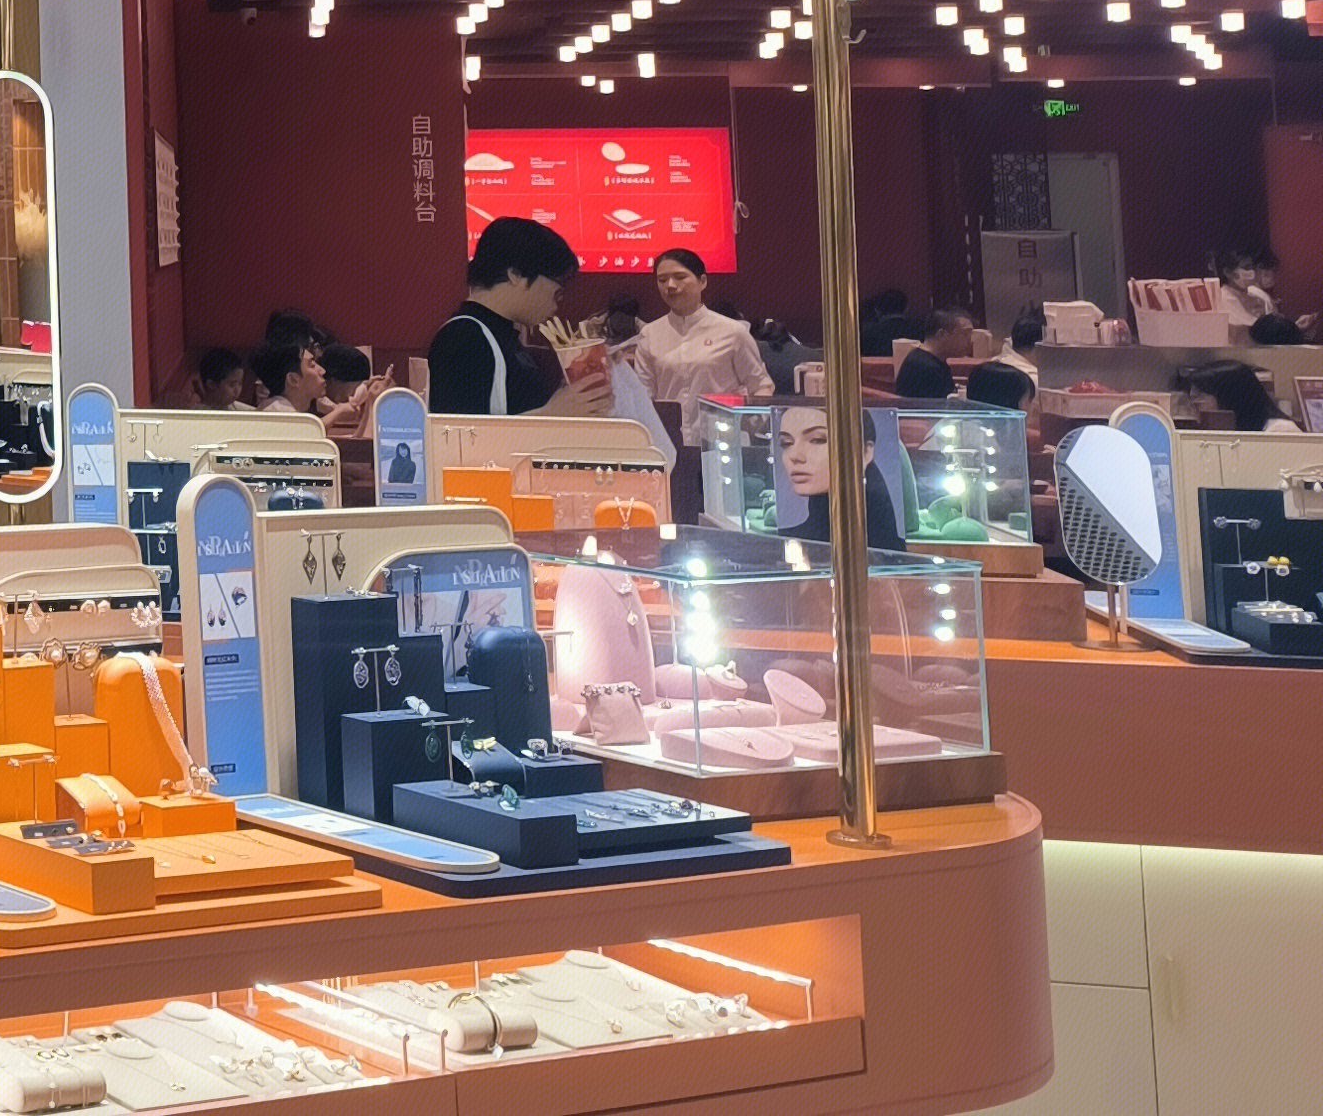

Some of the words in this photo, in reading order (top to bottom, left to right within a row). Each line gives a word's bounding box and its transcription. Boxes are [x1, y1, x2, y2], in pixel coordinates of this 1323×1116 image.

[411, 113, 437, 224] 自助调料台
